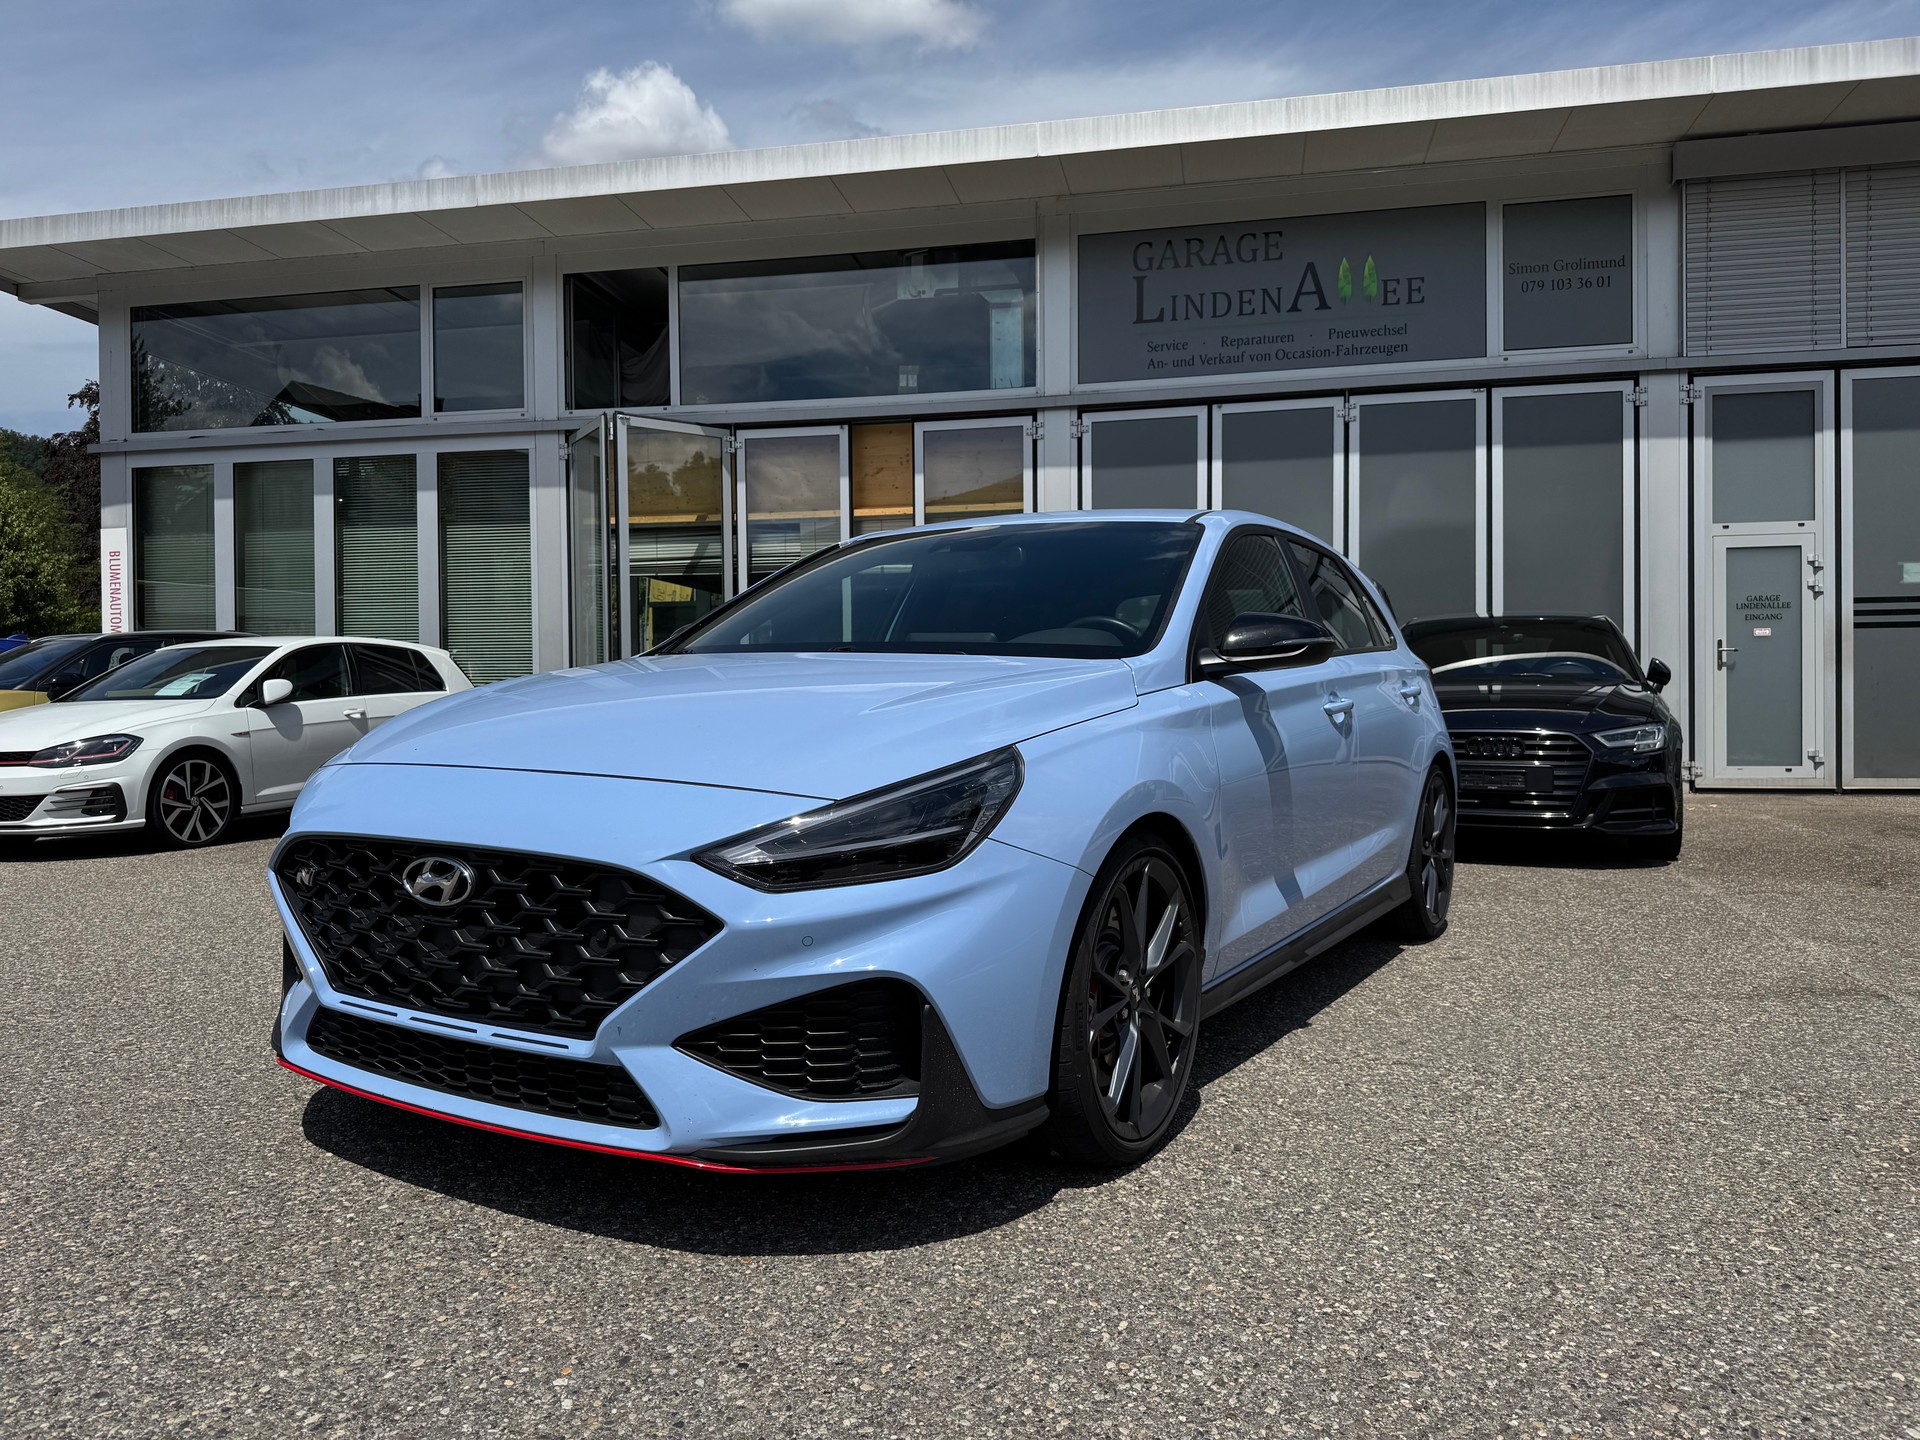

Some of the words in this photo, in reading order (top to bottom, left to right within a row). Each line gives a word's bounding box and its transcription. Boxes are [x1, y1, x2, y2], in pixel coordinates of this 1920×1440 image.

[1132, 231, 1284, 272] GARAGE
[1508, 262, 1549, 275] Simon
[1553, 255, 1626, 272] Grolimund
[1132, 261, 1425, 324] LINDENAEE
[1521, 280, 1545, 293] 079
[1551, 278, 1572, 291] 103
[1577, 277, 1592, 289] 36
[1596, 275, 1611, 288] 01
[1147, 339, 1189, 353] Service
[1221, 333, 1295, 349] Reparaturen
[1328, 322, 1408, 340] Pneuwechsel
[1147, 358, 1168, 370] An-
[1172, 355, 1195, 368] und
[1199, 351, 1246, 366] Verkauf
[1249, 352, 1271, 363] von
[1275, 343, 1409, 361] Occasion-Fahrzeugen
[1736, 601, 1792, 610] LINDENALLEE
[1746, 594, 1781, 602] GARAGE
[1744, 613, 1783, 621] EINGANG
